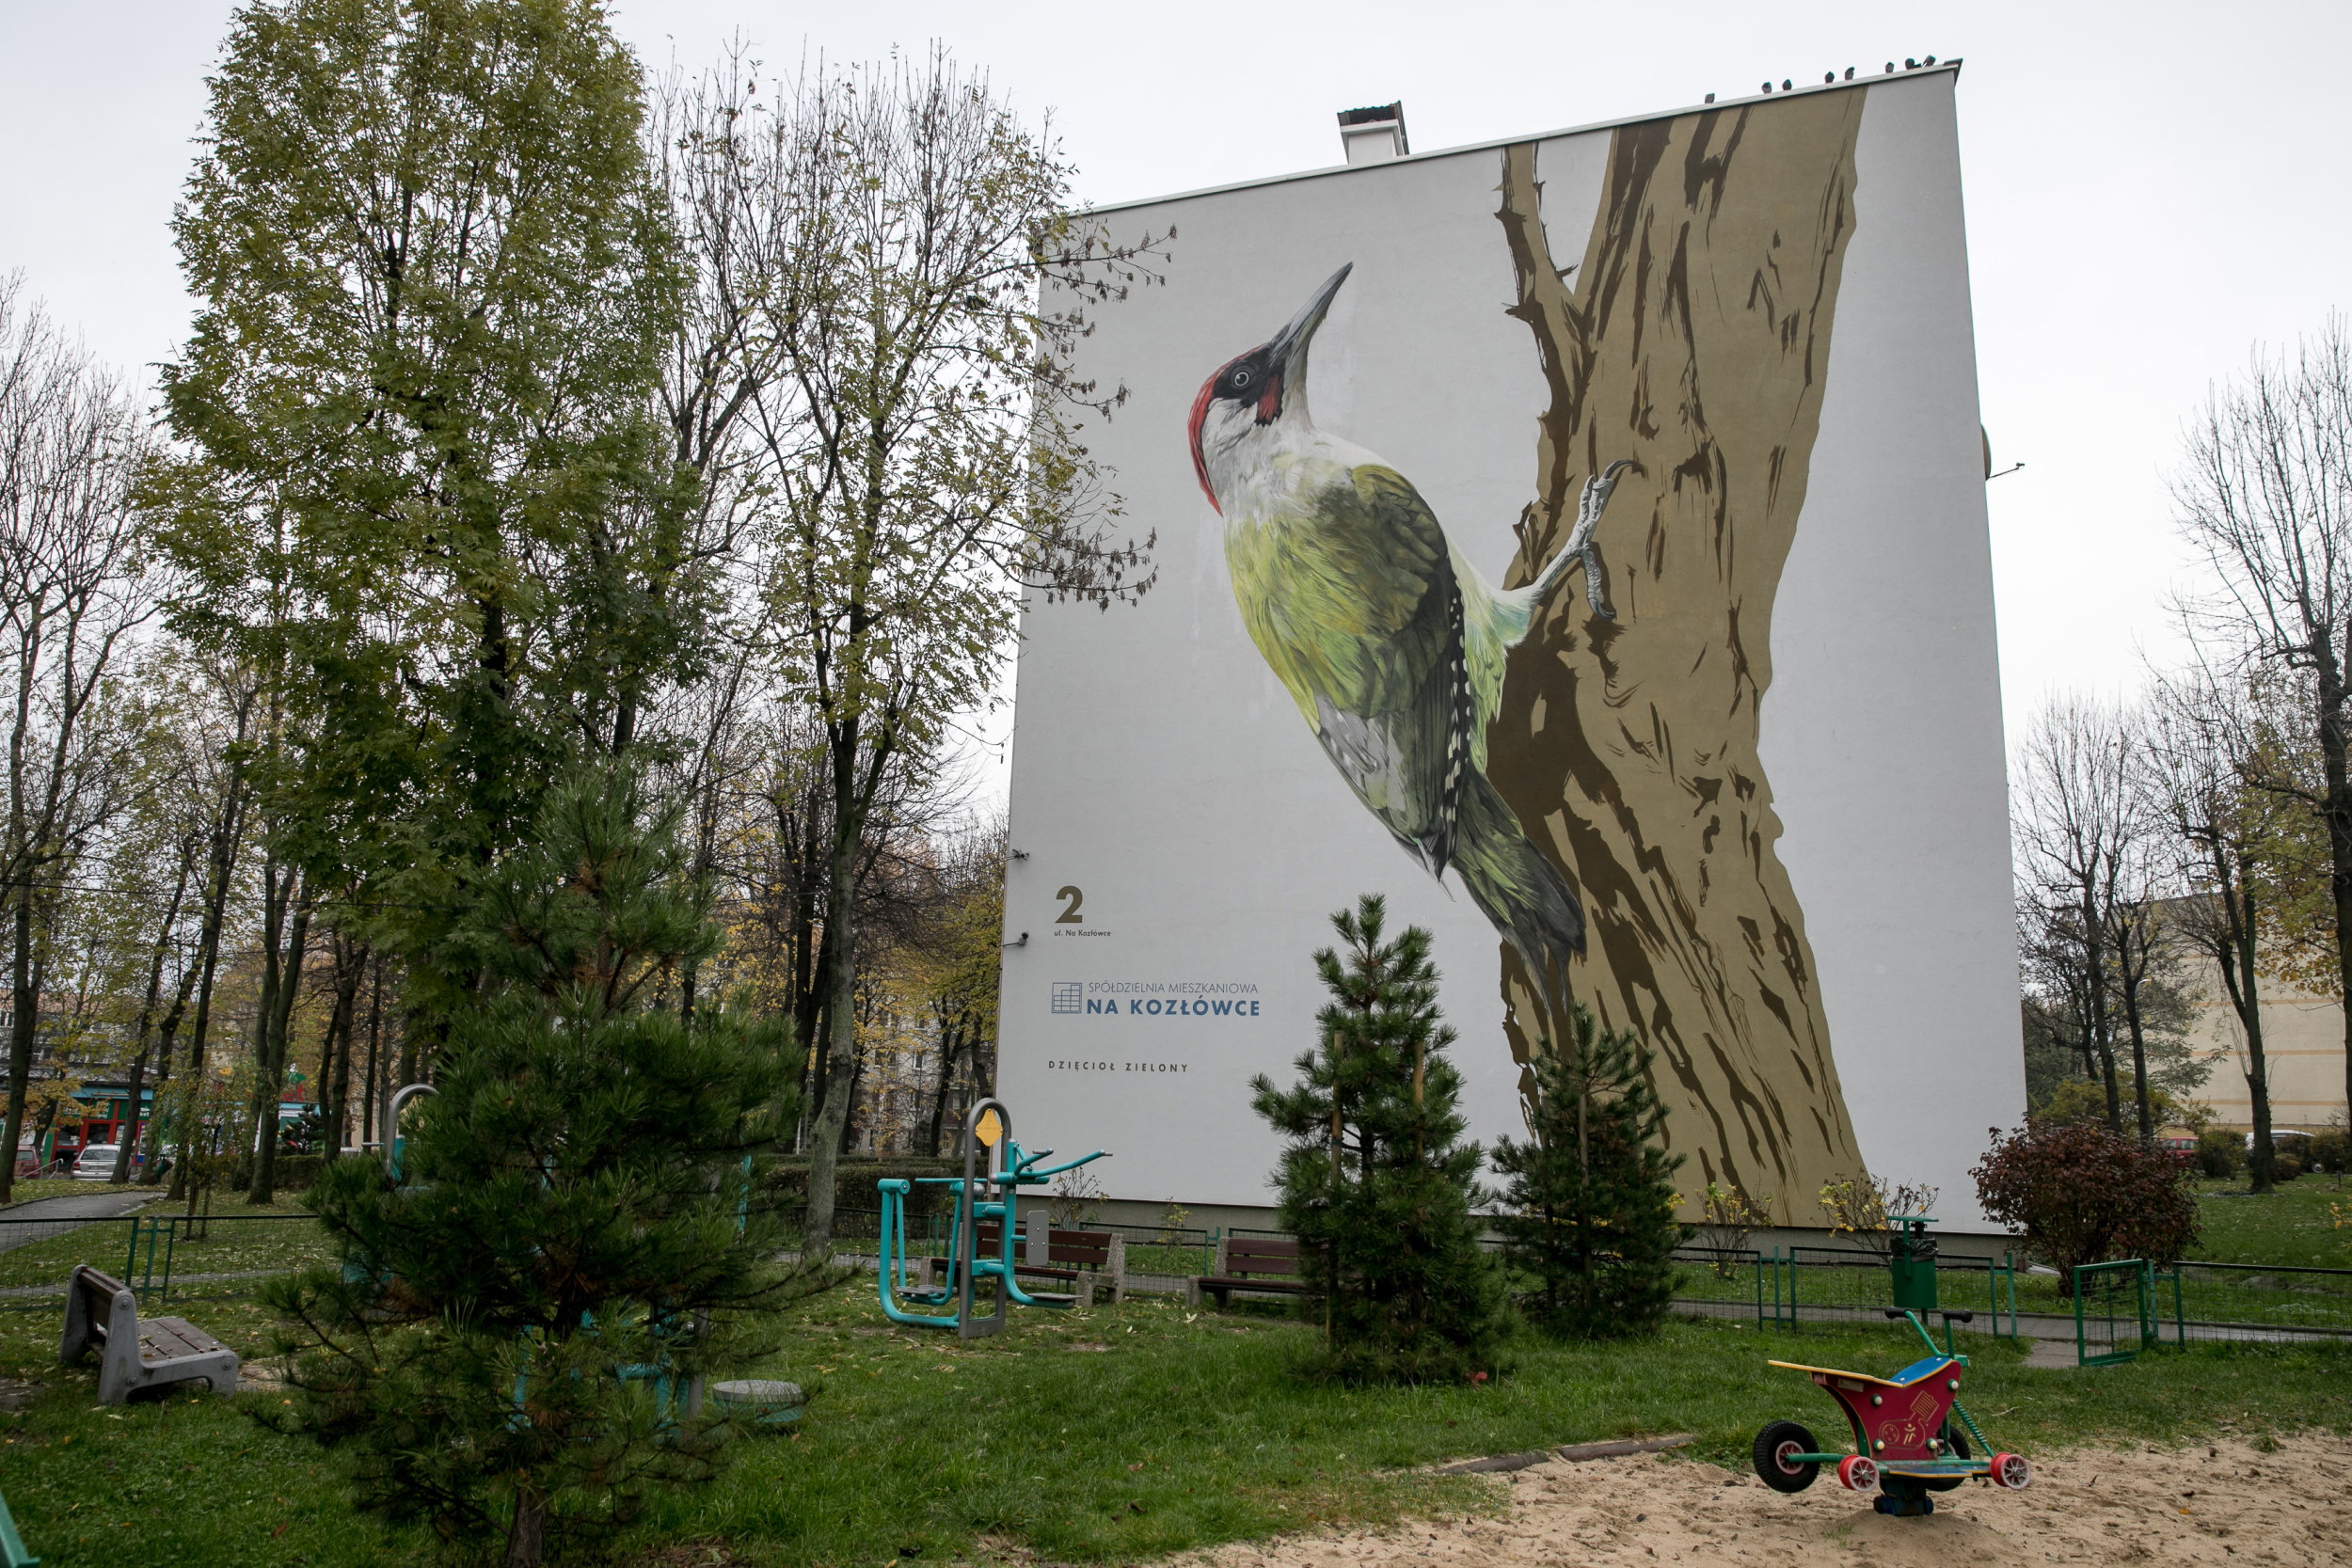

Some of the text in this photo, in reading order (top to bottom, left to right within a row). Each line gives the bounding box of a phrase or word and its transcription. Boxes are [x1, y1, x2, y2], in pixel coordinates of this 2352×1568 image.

[1055, 885, 1083, 924] 2
[1078, 928, 1111, 937] Kozłówce
[1089, 979, 1259, 994] SPÓŁDZIELNIA MIESZKANIOWA
[1087, 994, 1260, 1017] NA KOZŁÓWCE
[1048, 1060, 1188, 1073] DZIĘCIOŁ ZIELONY
